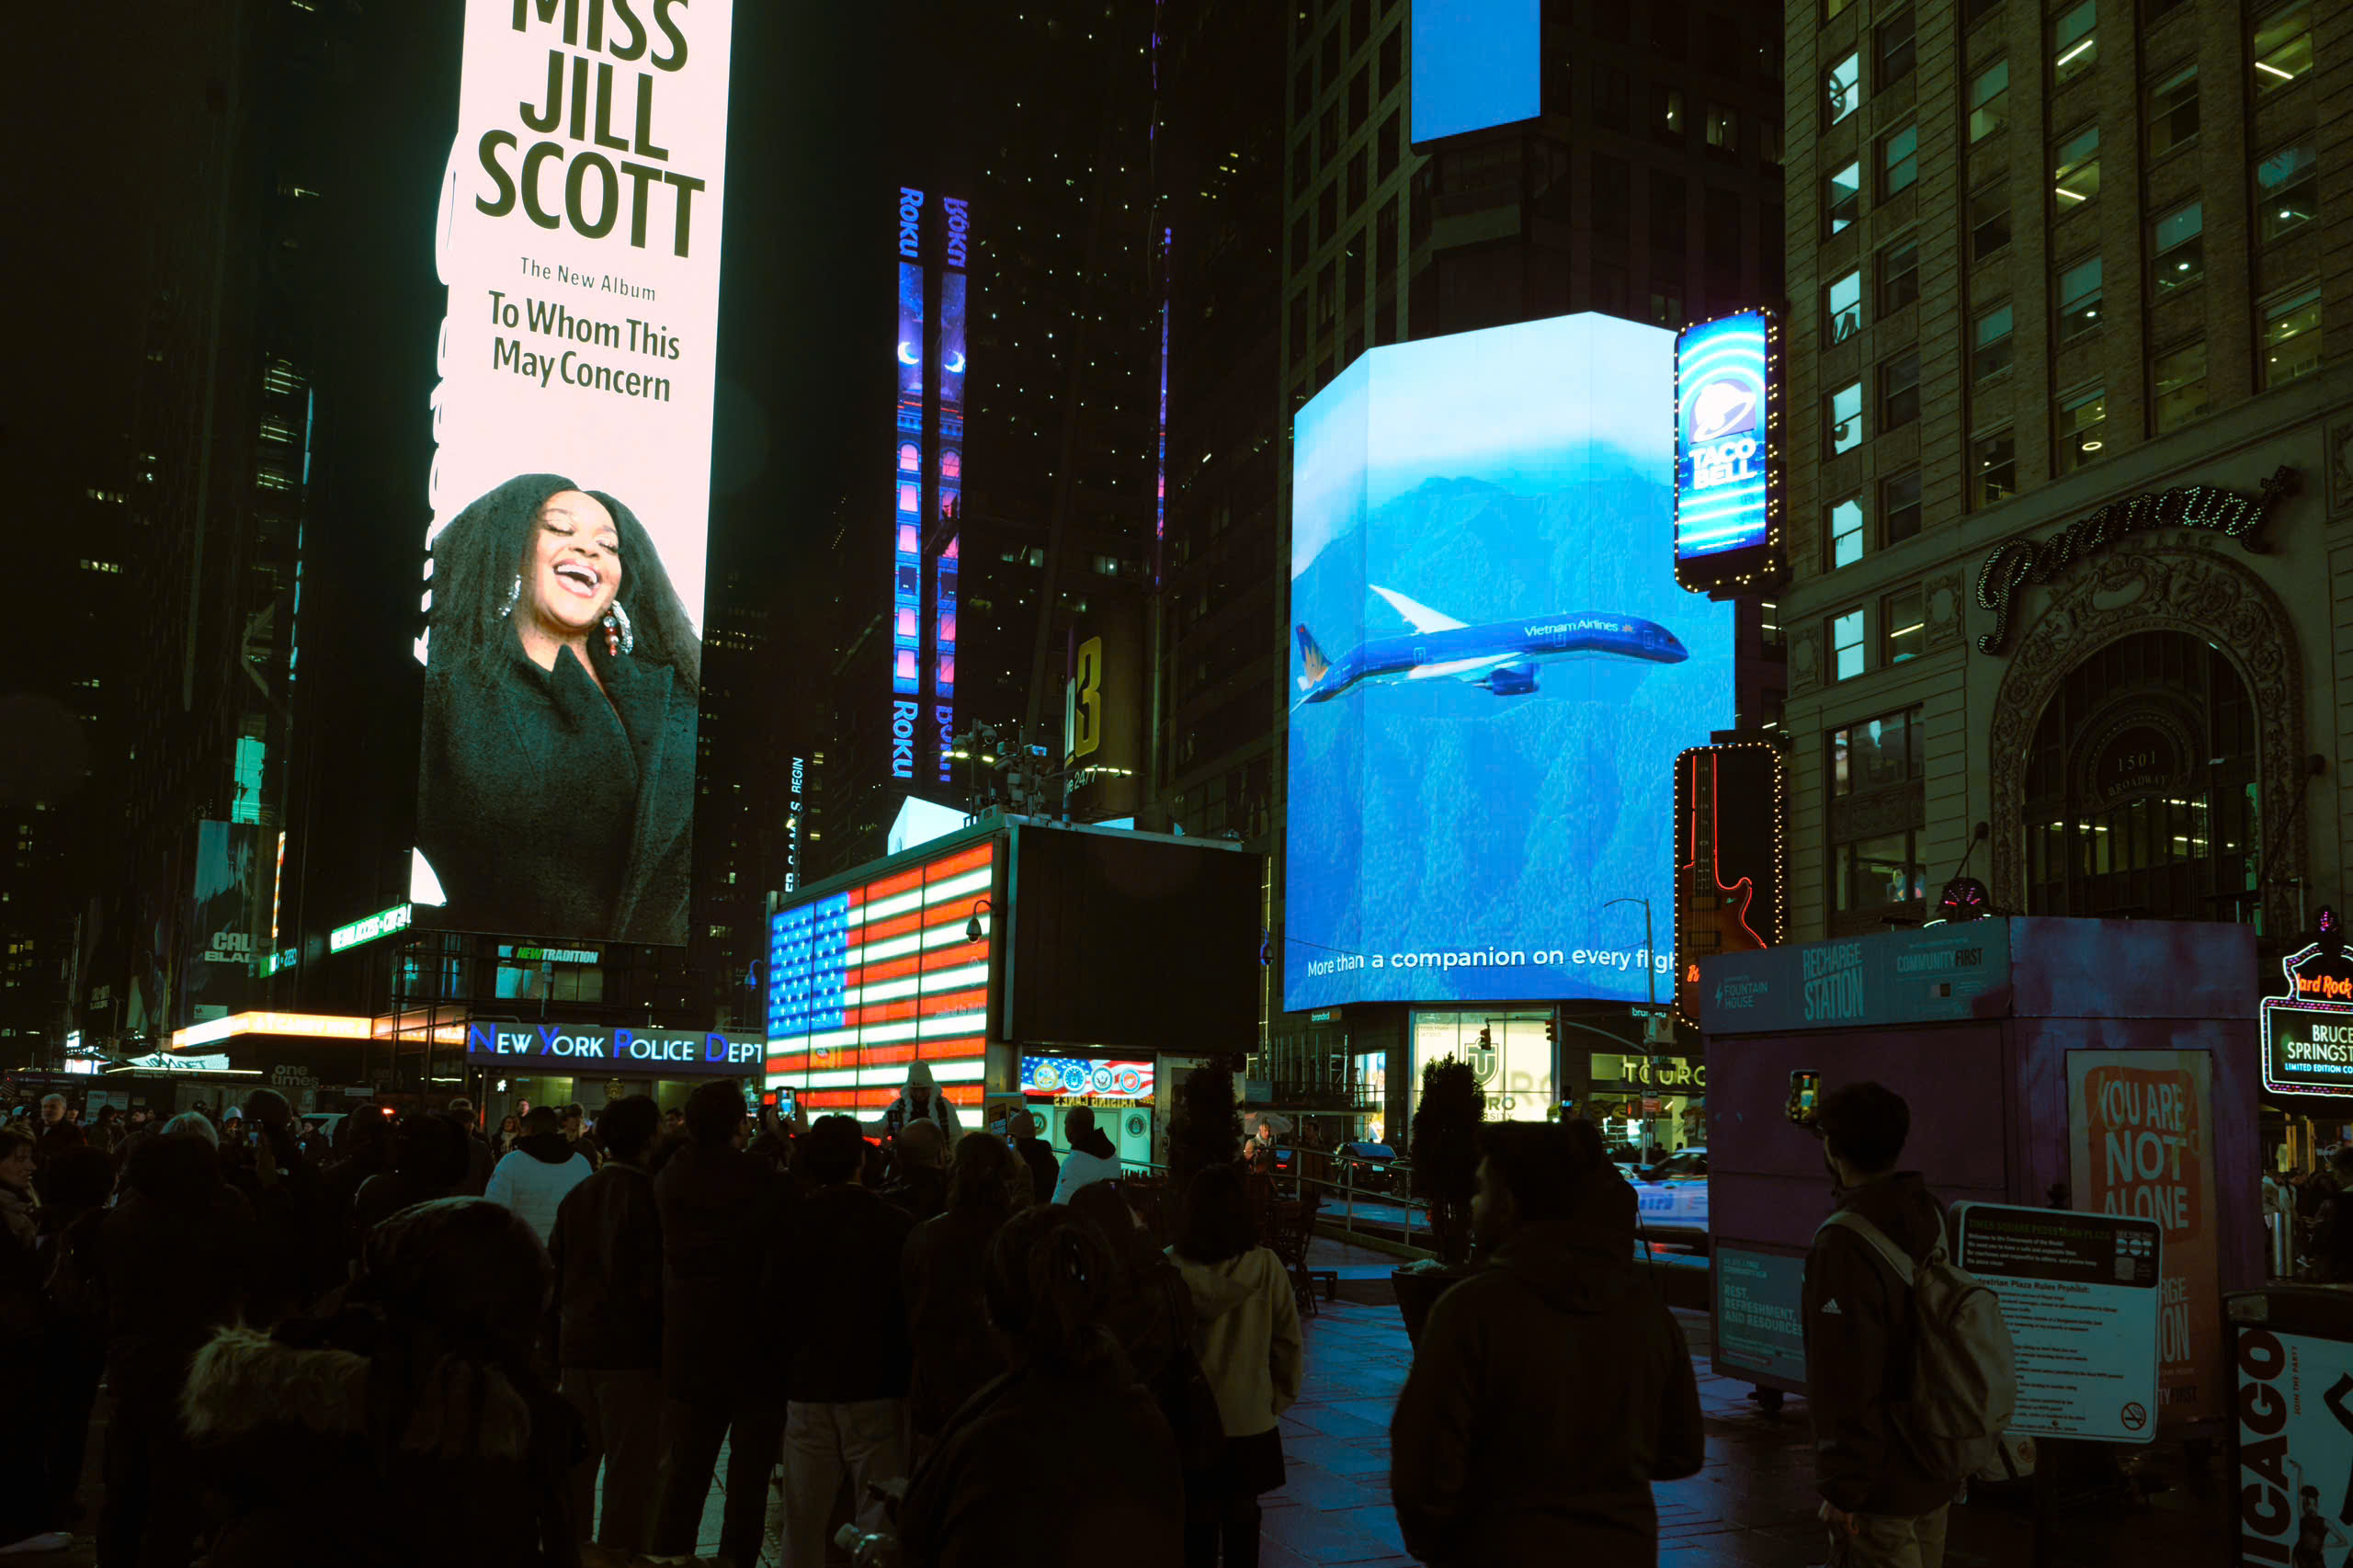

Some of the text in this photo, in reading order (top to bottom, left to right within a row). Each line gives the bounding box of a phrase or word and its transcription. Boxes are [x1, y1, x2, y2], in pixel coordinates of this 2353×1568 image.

[519, 49, 670, 162] JILL
[475, 129, 706, 258] SCOTT
[520, 256, 656, 301] The New Album
[488, 290, 680, 360] To Whom This
[492, 336, 671, 402] May Concern
[1688, 438, 1756, 470] TACO
[1693, 459, 1758, 490] BELL
[1977, 465, 2290, 656] Paramount
[1524, 619, 1619, 638] Vietnam Airlines
[2118, 750, 2155, 773] 1501
[2108, 774, 2169, 796] BROADWAY
[1308, 960, 1335, 977] More
[1336, 953, 1365, 972] than
[1371, 954, 1384, 968] a
[1391, 946, 1526, 971] companion
[1532, 949, 1563, 965] on
[1572, 949, 1631, 971] every
[1802, 942, 1865, 981] RECHARGE
[1724, 981, 1769, 995] FOUNTAIN
[1724, 995, 1756, 1008] HOUSE
[1804, 966, 1865, 1022] STATION
[469, 1023, 533, 1055] NEW
[538, 1025, 605, 1058] YORK
[613, 1028, 695, 1062] POLICE
[705, 1032, 763, 1063] DEPT
[2312, 1024, 2353, 1044] BRUCE
[271, 1072, 319, 1087] times
[275, 1063, 309, 1076] one
[2285, 1062, 2313, 1073] LIMITED
[2313, 1063, 2342, 1074] EDITION
[2100, 1076, 2187, 1133] YOU ARE
[2105, 1130, 2188, 1187] NOT
